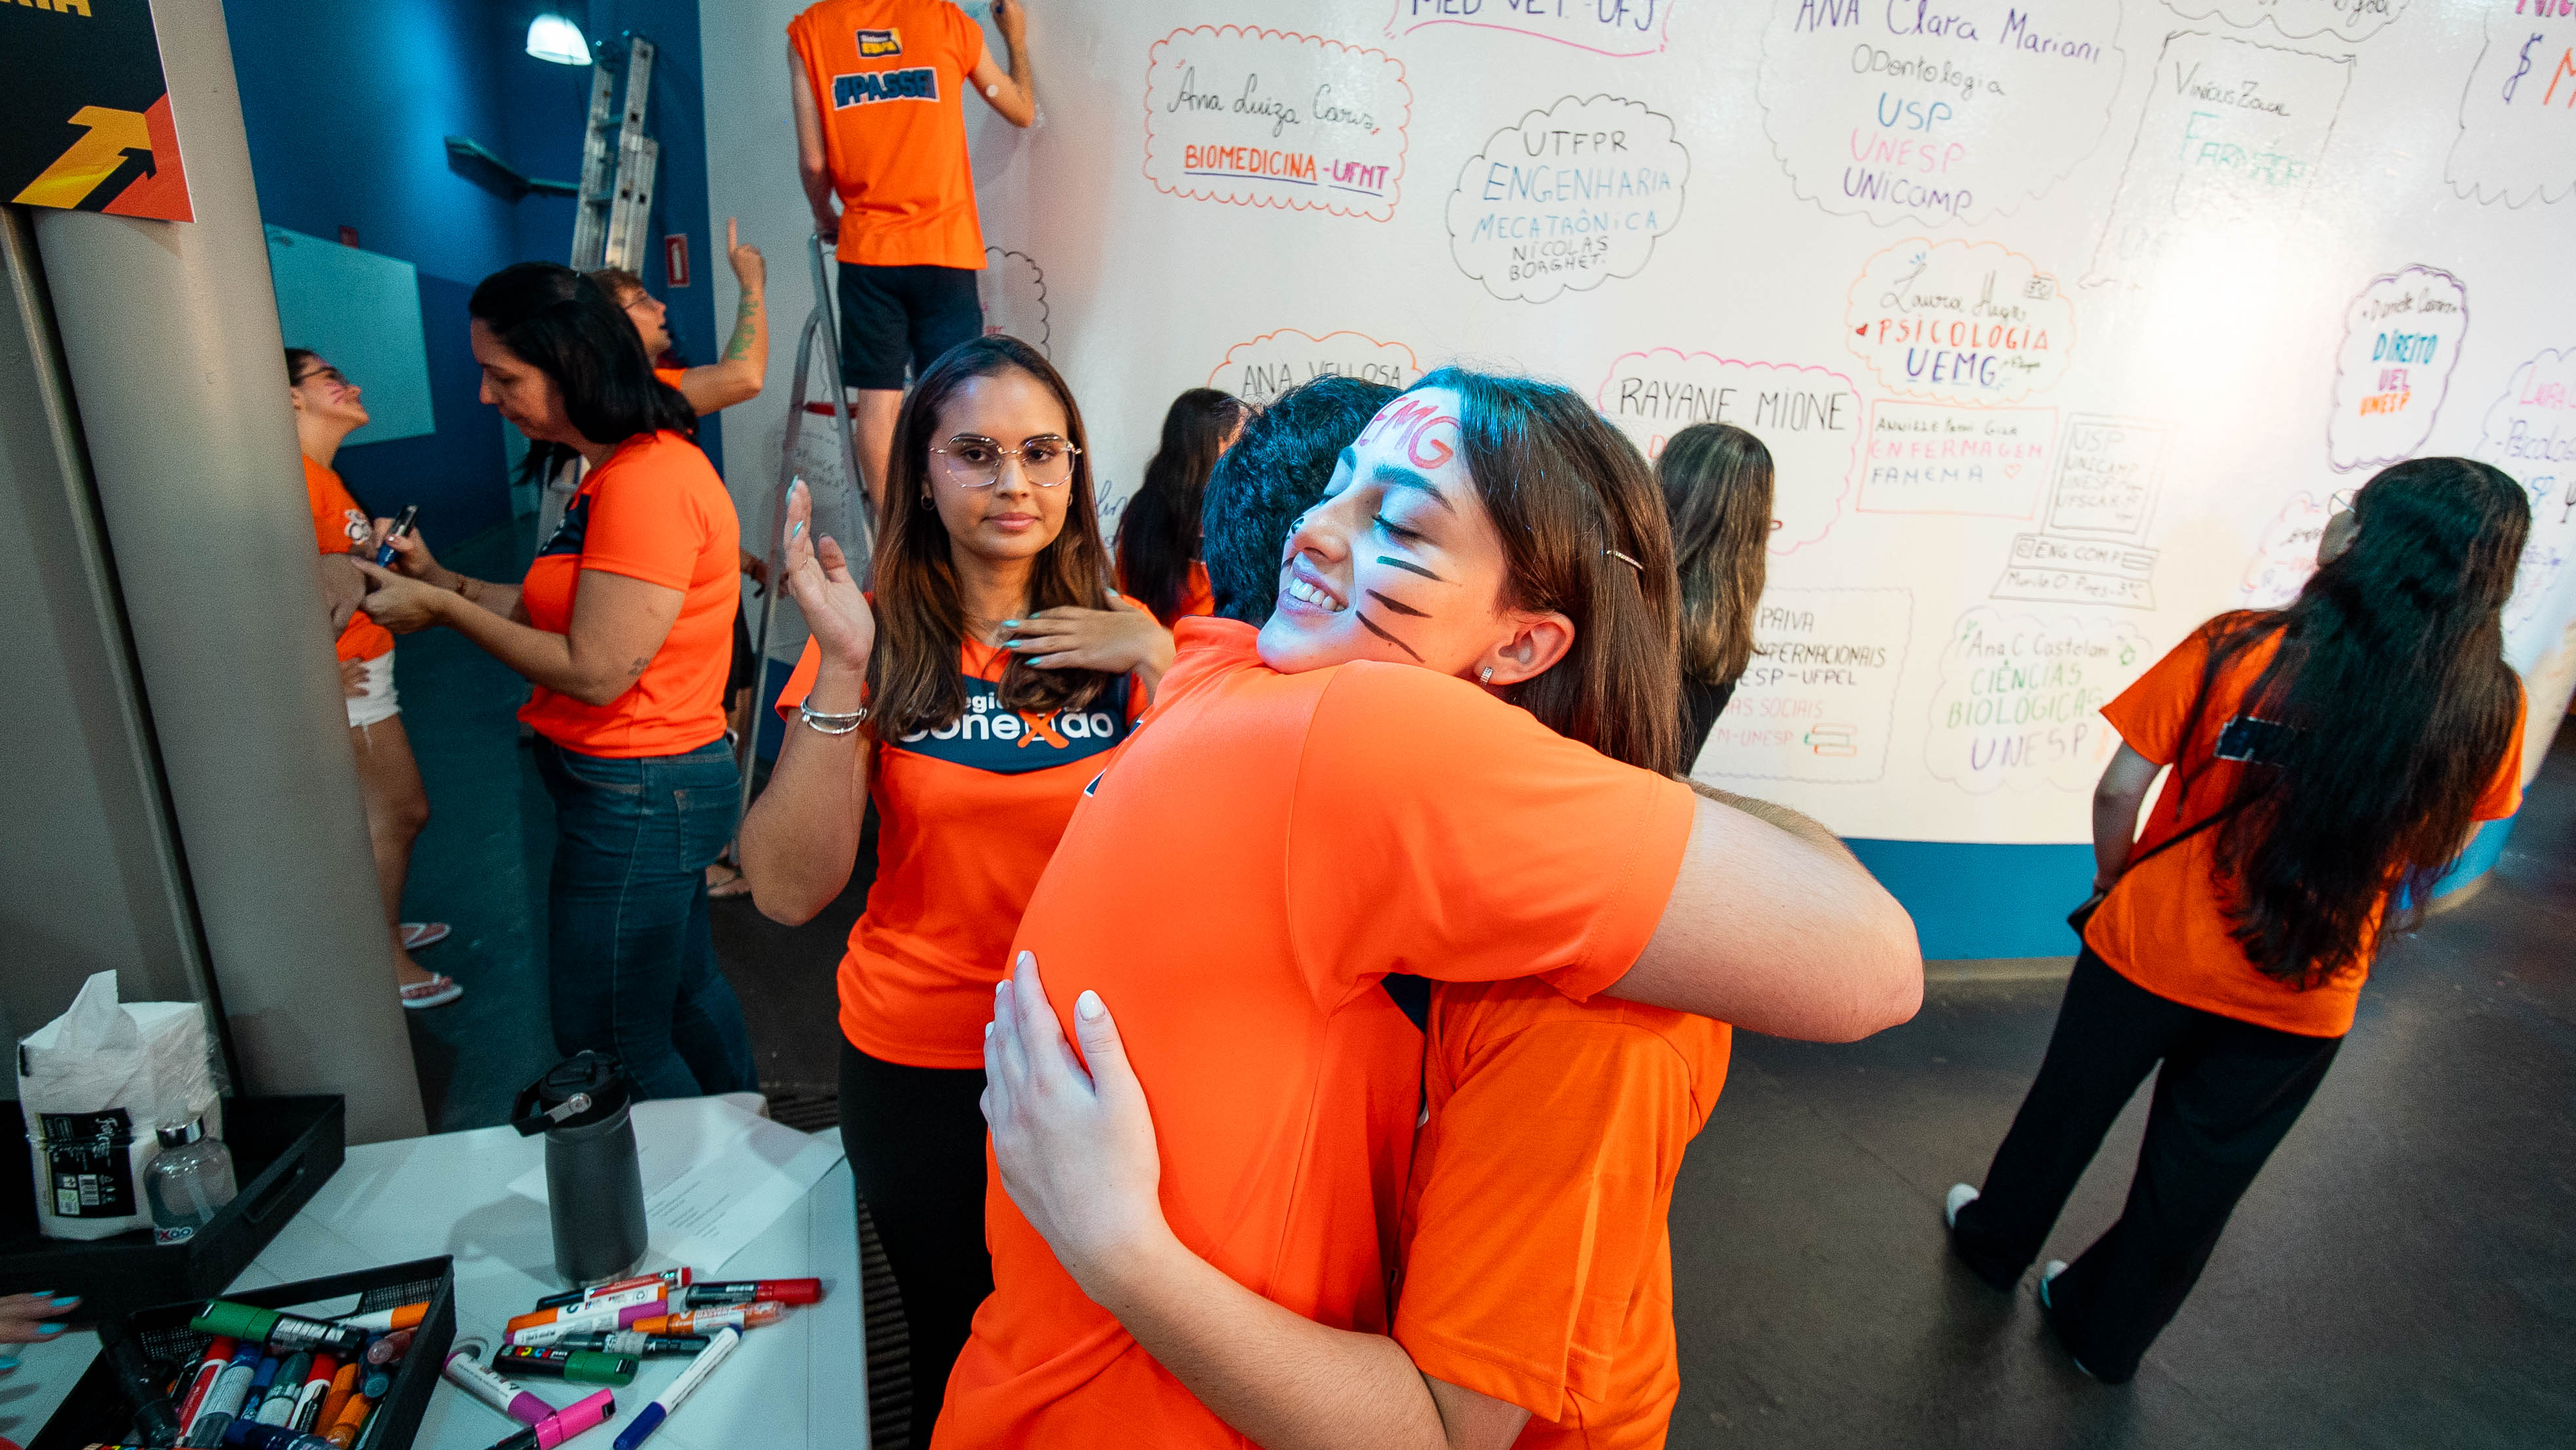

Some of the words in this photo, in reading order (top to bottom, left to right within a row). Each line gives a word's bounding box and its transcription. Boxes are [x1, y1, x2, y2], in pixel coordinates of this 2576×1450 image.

[1794, 0, 1860, 32] ANA
[1886, 0, 1978, 42] Clara
[1878, 92, 1953, 132] USP
[1522, 130, 1629, 157] UTFPR
[1850, 129, 1966, 174] UNESP
[1482, 161, 1672, 204] ENGENHARIA
[1906, 348, 1997, 387] UEMG
[1620, 377, 1738, 424] RAYANE
[1759, 607, 1815, 634] PAIVA
[1971, 721, 2088, 771] UNESP
